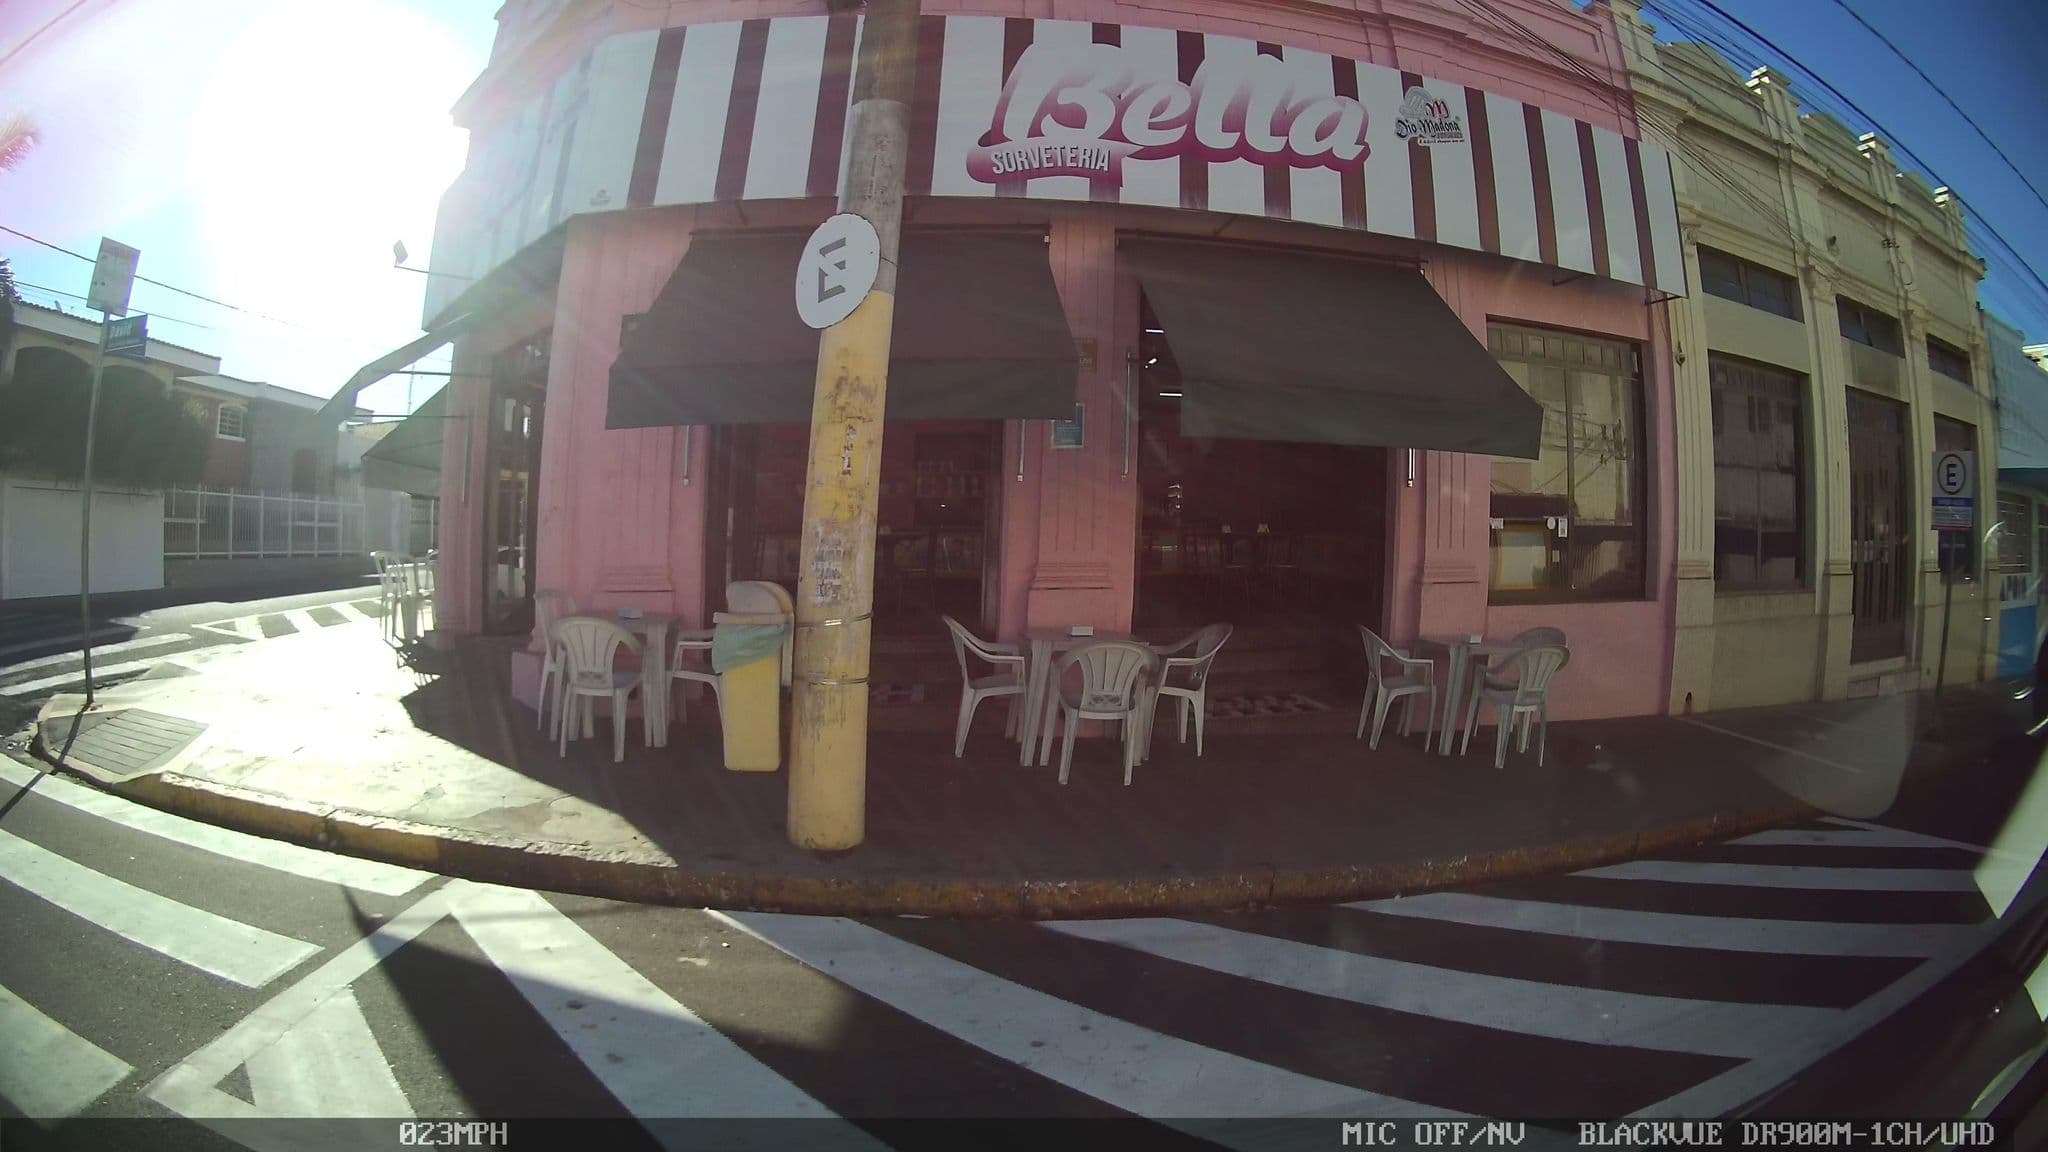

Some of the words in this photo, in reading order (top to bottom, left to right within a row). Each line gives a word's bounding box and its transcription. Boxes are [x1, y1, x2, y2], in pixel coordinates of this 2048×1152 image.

[998, 42, 1368, 162] Bella
[1395, 118, 1418, 138] Dio
[1419, 118, 1461, 138] Madona
[991, 145, 1111, 174] SORVETERIA
[1946, 463, 1957, 487] E
